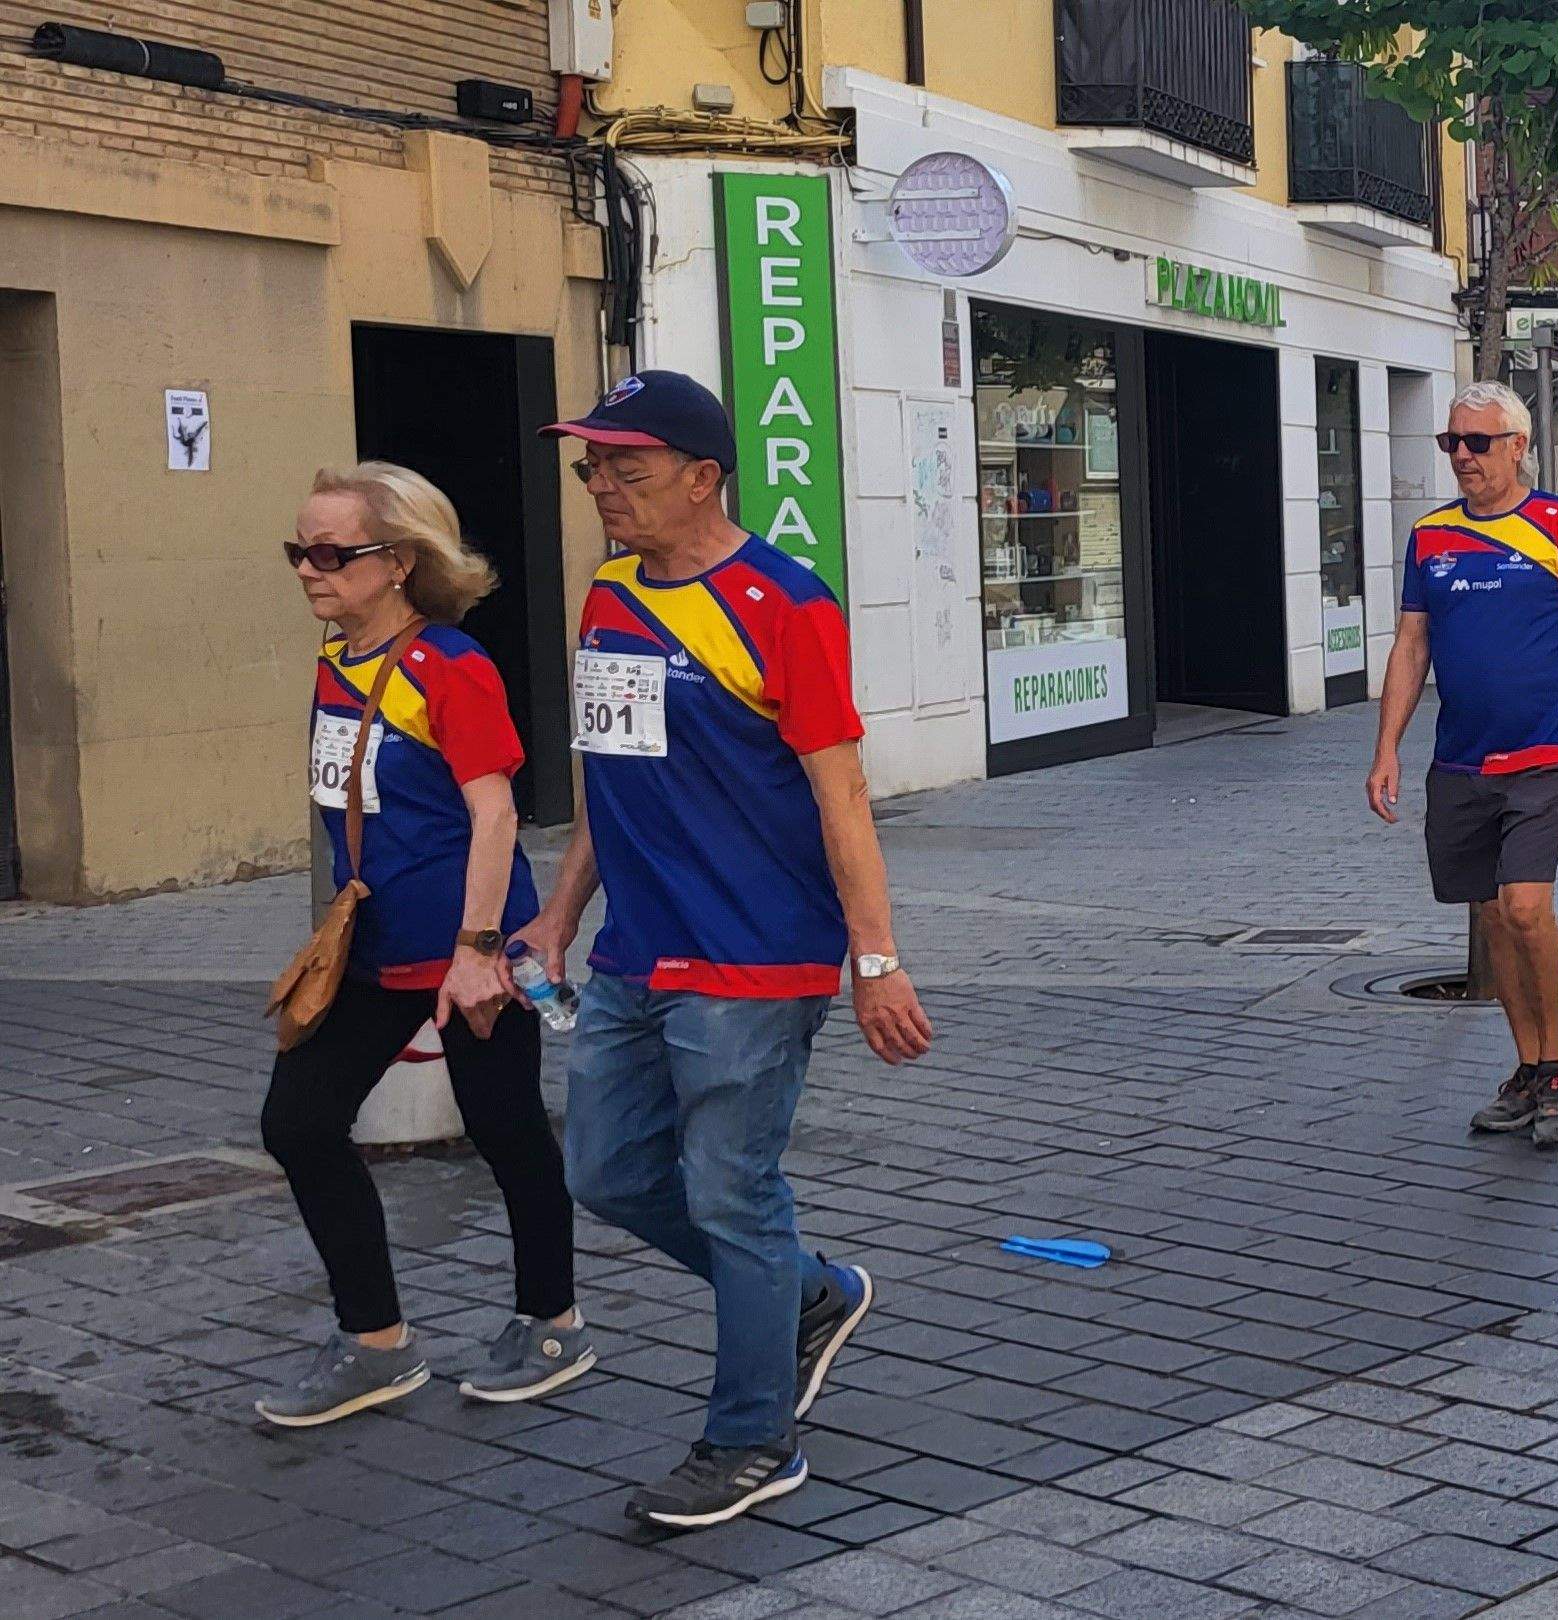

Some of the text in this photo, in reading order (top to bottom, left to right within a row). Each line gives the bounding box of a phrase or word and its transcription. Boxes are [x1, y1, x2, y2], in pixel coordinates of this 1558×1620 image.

[1516, 313, 1534, 331] el
[1472, 578, 1502, 591] mupol
[668, 667, 707, 684] tander
[1014, 664, 1108, 713] REPARACIONES
[584, 702, 633, 735] 501
